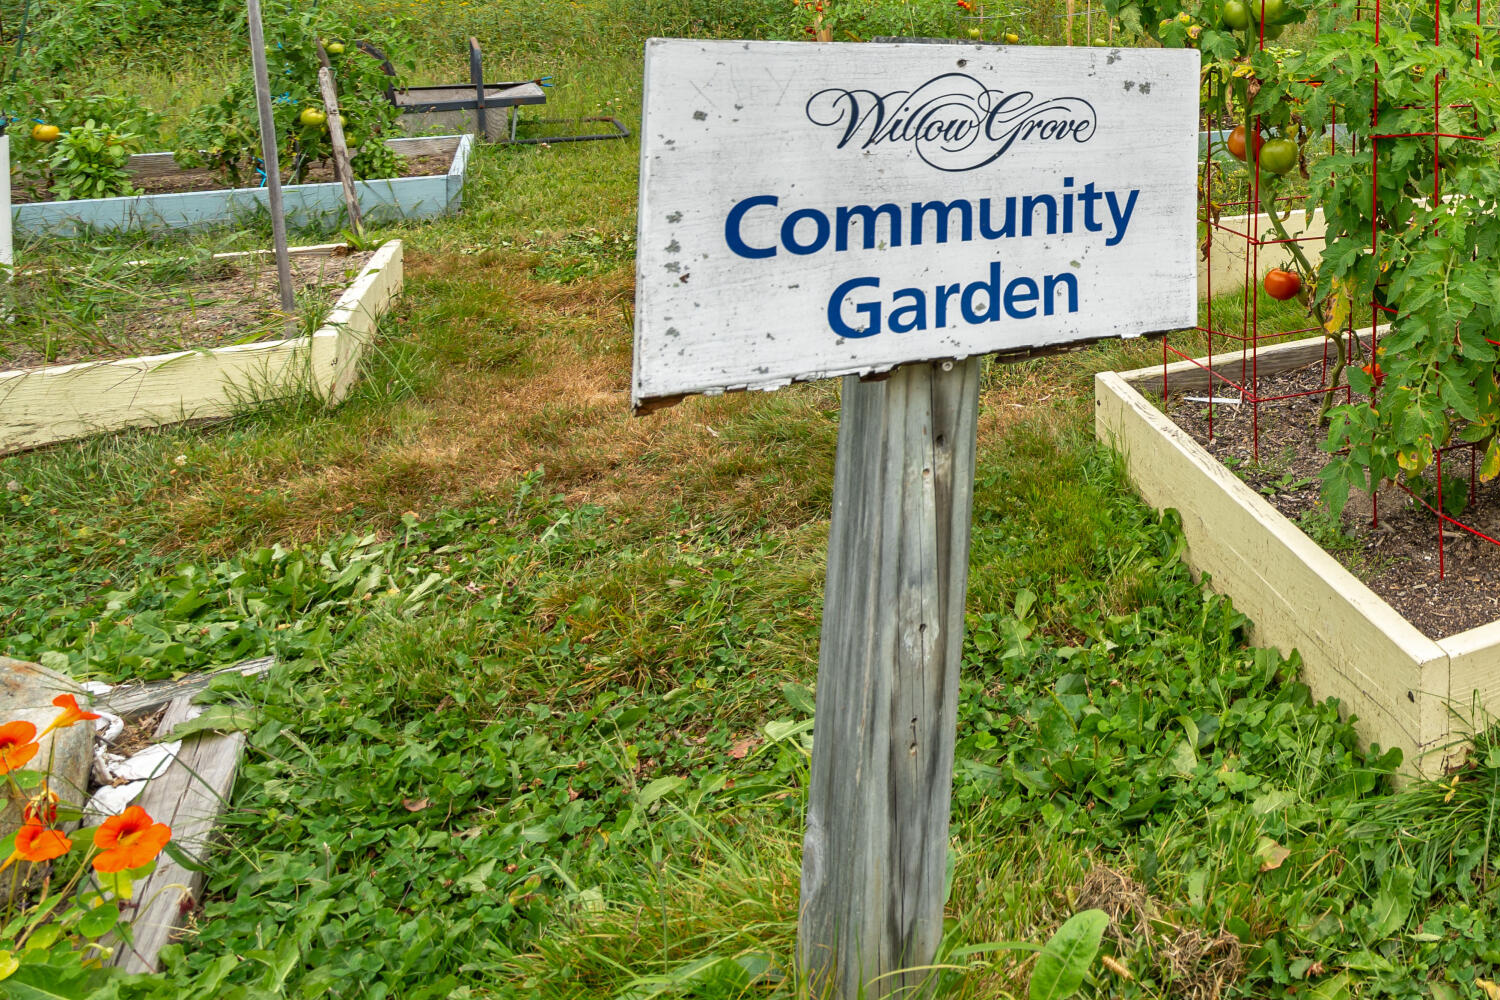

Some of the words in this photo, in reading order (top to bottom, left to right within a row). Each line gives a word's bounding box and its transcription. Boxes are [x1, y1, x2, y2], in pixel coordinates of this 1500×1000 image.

[806, 72, 990, 152] Willow
[978, 90, 1097, 172] Grove
[724, 176, 1140, 260] Community
[827, 261, 1079, 339] Garden
